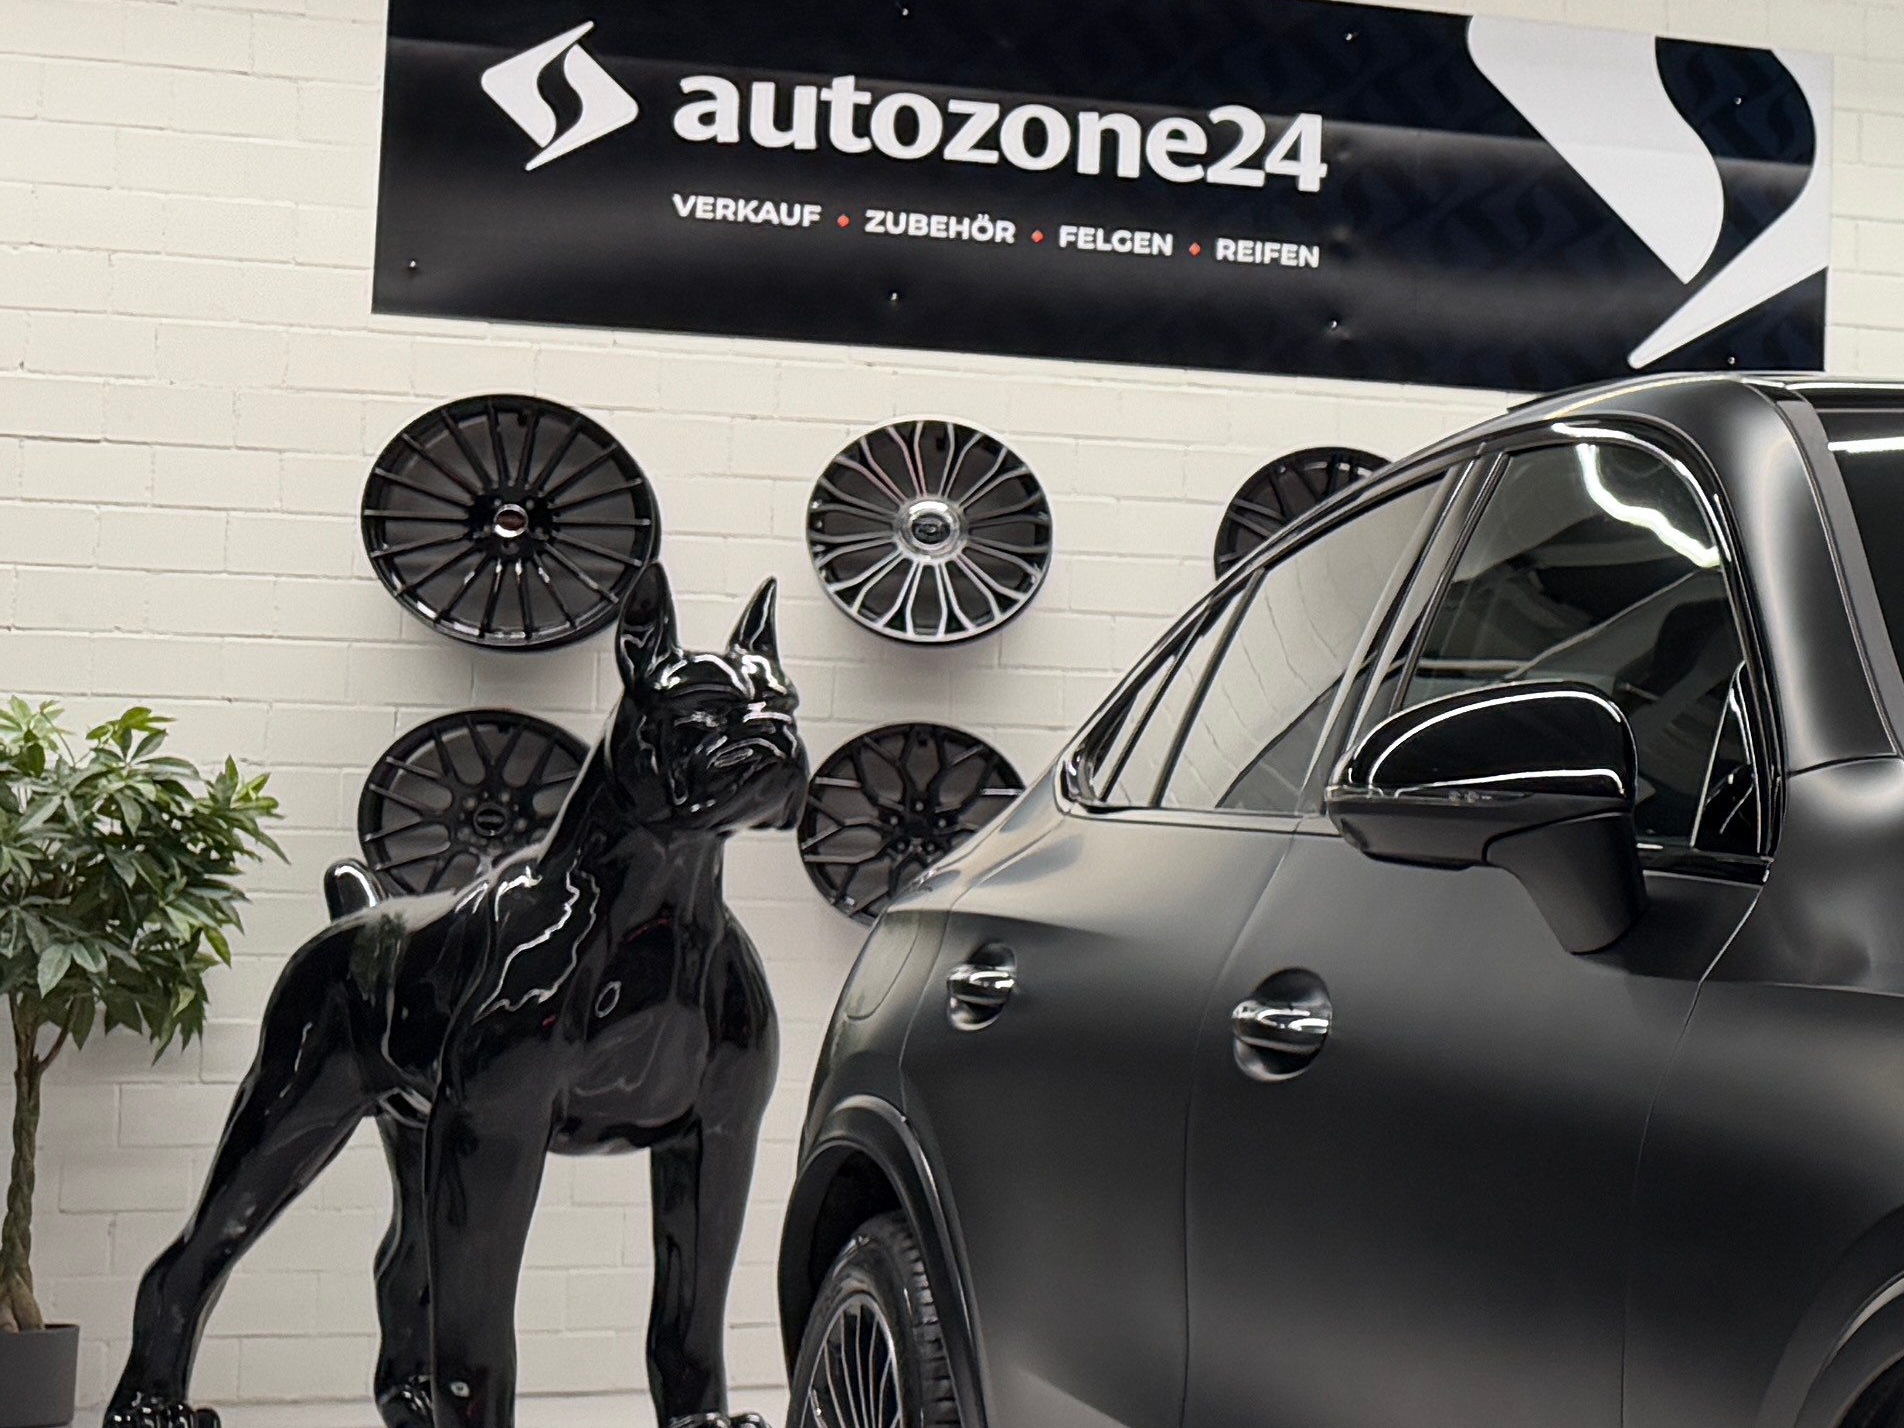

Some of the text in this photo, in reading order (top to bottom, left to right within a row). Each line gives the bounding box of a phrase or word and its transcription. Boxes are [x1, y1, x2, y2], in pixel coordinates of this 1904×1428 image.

[671, 74, 1328, 193] autozone24
[672, 193, 1320, 269] VERKAUF ZUBEHÖR FELGEN REIFEN
